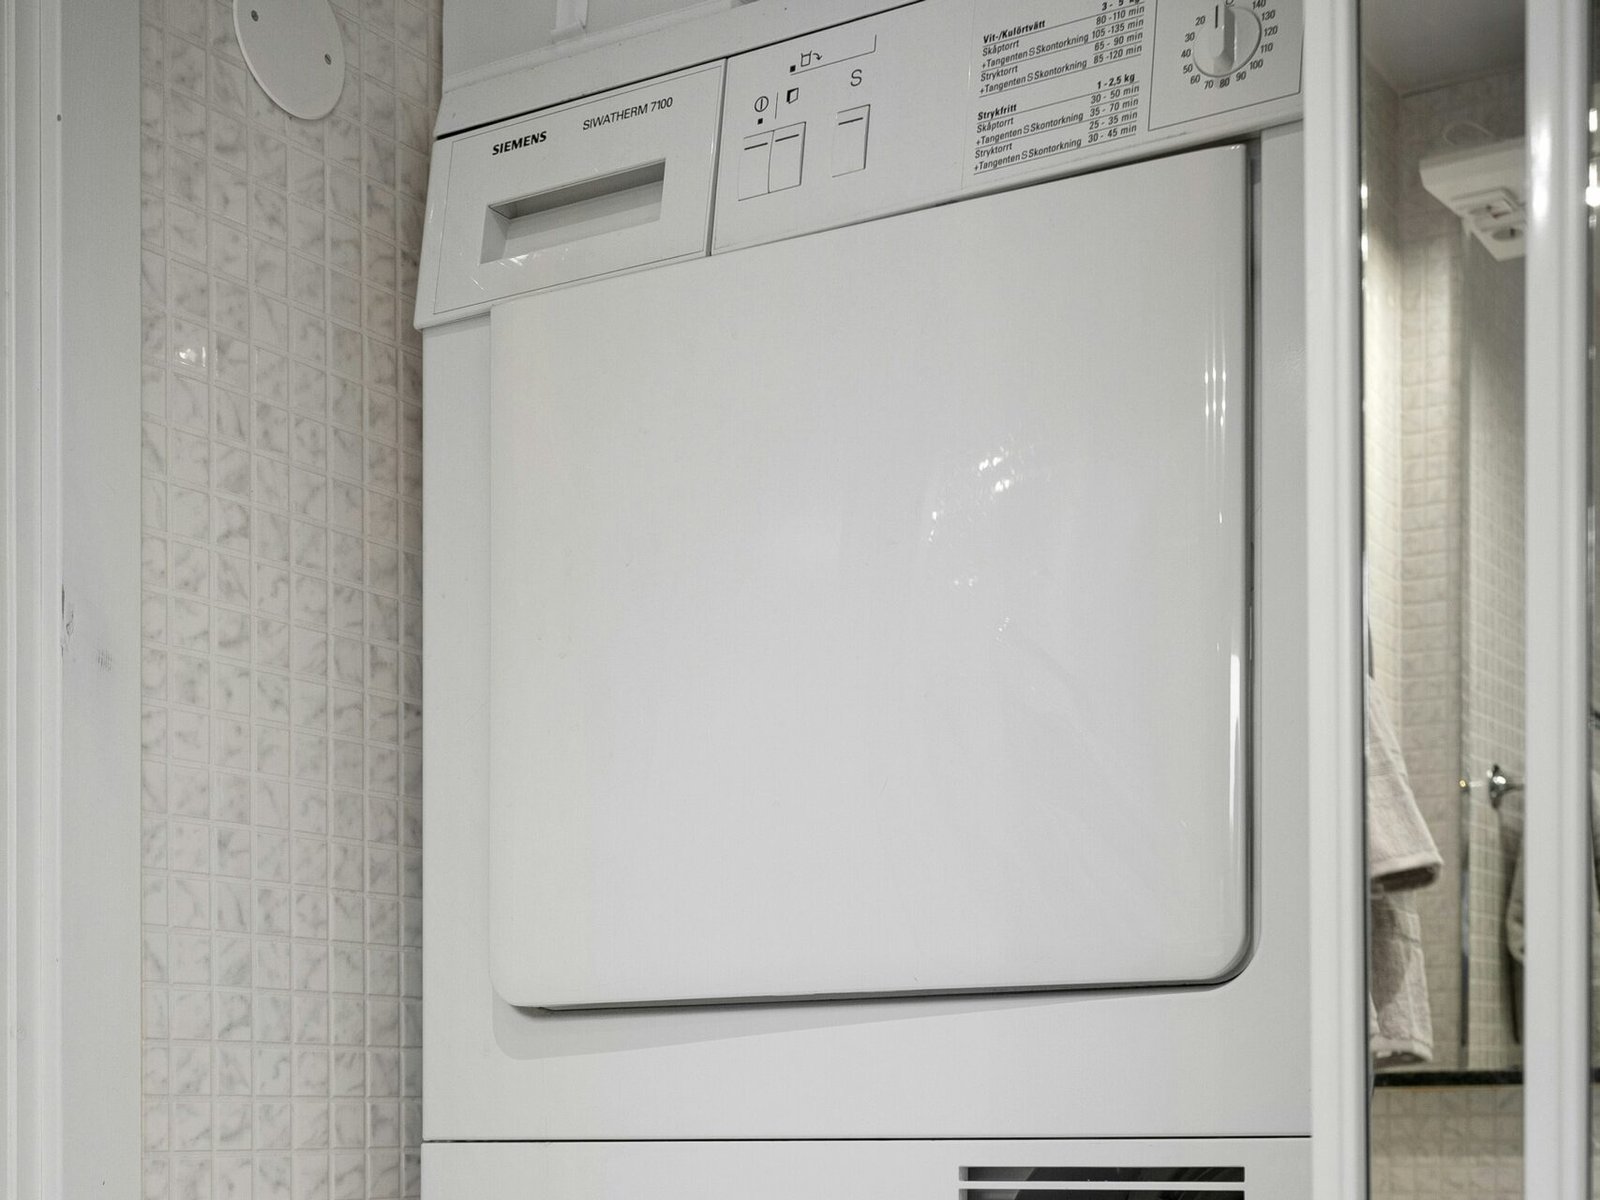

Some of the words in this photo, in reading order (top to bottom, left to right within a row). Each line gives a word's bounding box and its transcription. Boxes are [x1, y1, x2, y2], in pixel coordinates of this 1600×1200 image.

[1102, 2, 1107, 11] 3
[1195, 15, 1206, 26] 20
[1262, 10, 1276, 21] 130
[982, 40, 1019, 57] Skåptorrt
[1096, 15, 1106, 26] 80
[1128, 5, 1145, 16] min
[1036, 34, 1089, 55] Skontorkning
[1092, 28, 1105, 39] 105
[1127, 18, 1144, 30] min
[1184, 32, 1195, 42] 30
[1264, 25, 1278, 37] 120
[1181, 48, 1192, 58] 40
[1261, 42, 1273, 54] 110
[981, 65, 1018, 82] Stryktorrt
[1113, 36, 1124, 47] 90
[1126, 31, 1143, 43] min
[1034, 60, 1087, 80] Skontorkning
[1093, 54, 1104, 64] 85
[1125, 44, 1142, 56] min
[1183, 64, 1193, 74] 50
[1250, 59, 1264, 70] 100
[850, 69, 862, 87] S
[1190, 74, 1201, 85] 60
[1219, 77, 1230, 88] 80
[1236, 71, 1247, 82] 90
[1204, 79, 1214, 90] 70
[977, 104, 1017, 122] Strykfritt
[1097, 80, 1101, 90] 1
[1124, 73, 1135, 84] kg
[582, 103, 648, 131] SIWATHERM
[650, 96, 673, 112] 7100
[976, 117, 1014, 134] Skåptorrt
[1091, 94, 1101, 104] 30
[1110, 89, 1121, 100] 50
[1123, 85, 1140, 96] min
[1030, 112, 1084, 133] Skontorkning
[1090, 107, 1100, 117] 35
[1110, 102, 1120, 112] 70
[1122, 98, 1139, 109] min
[974, 142, 1012, 159] Stryktorrt
[1089, 120, 1100, 130] 25
[1108, 115, 1119, 125] 35
[1121, 111, 1138, 122] min
[492, 131, 547, 156] SIEMENS
[1028, 138, 1082, 159] Skontorkning
[1088, 132, 1099, 143] 30
[1107, 128, 1118, 138] 45
[1120, 124, 1137, 135] min
